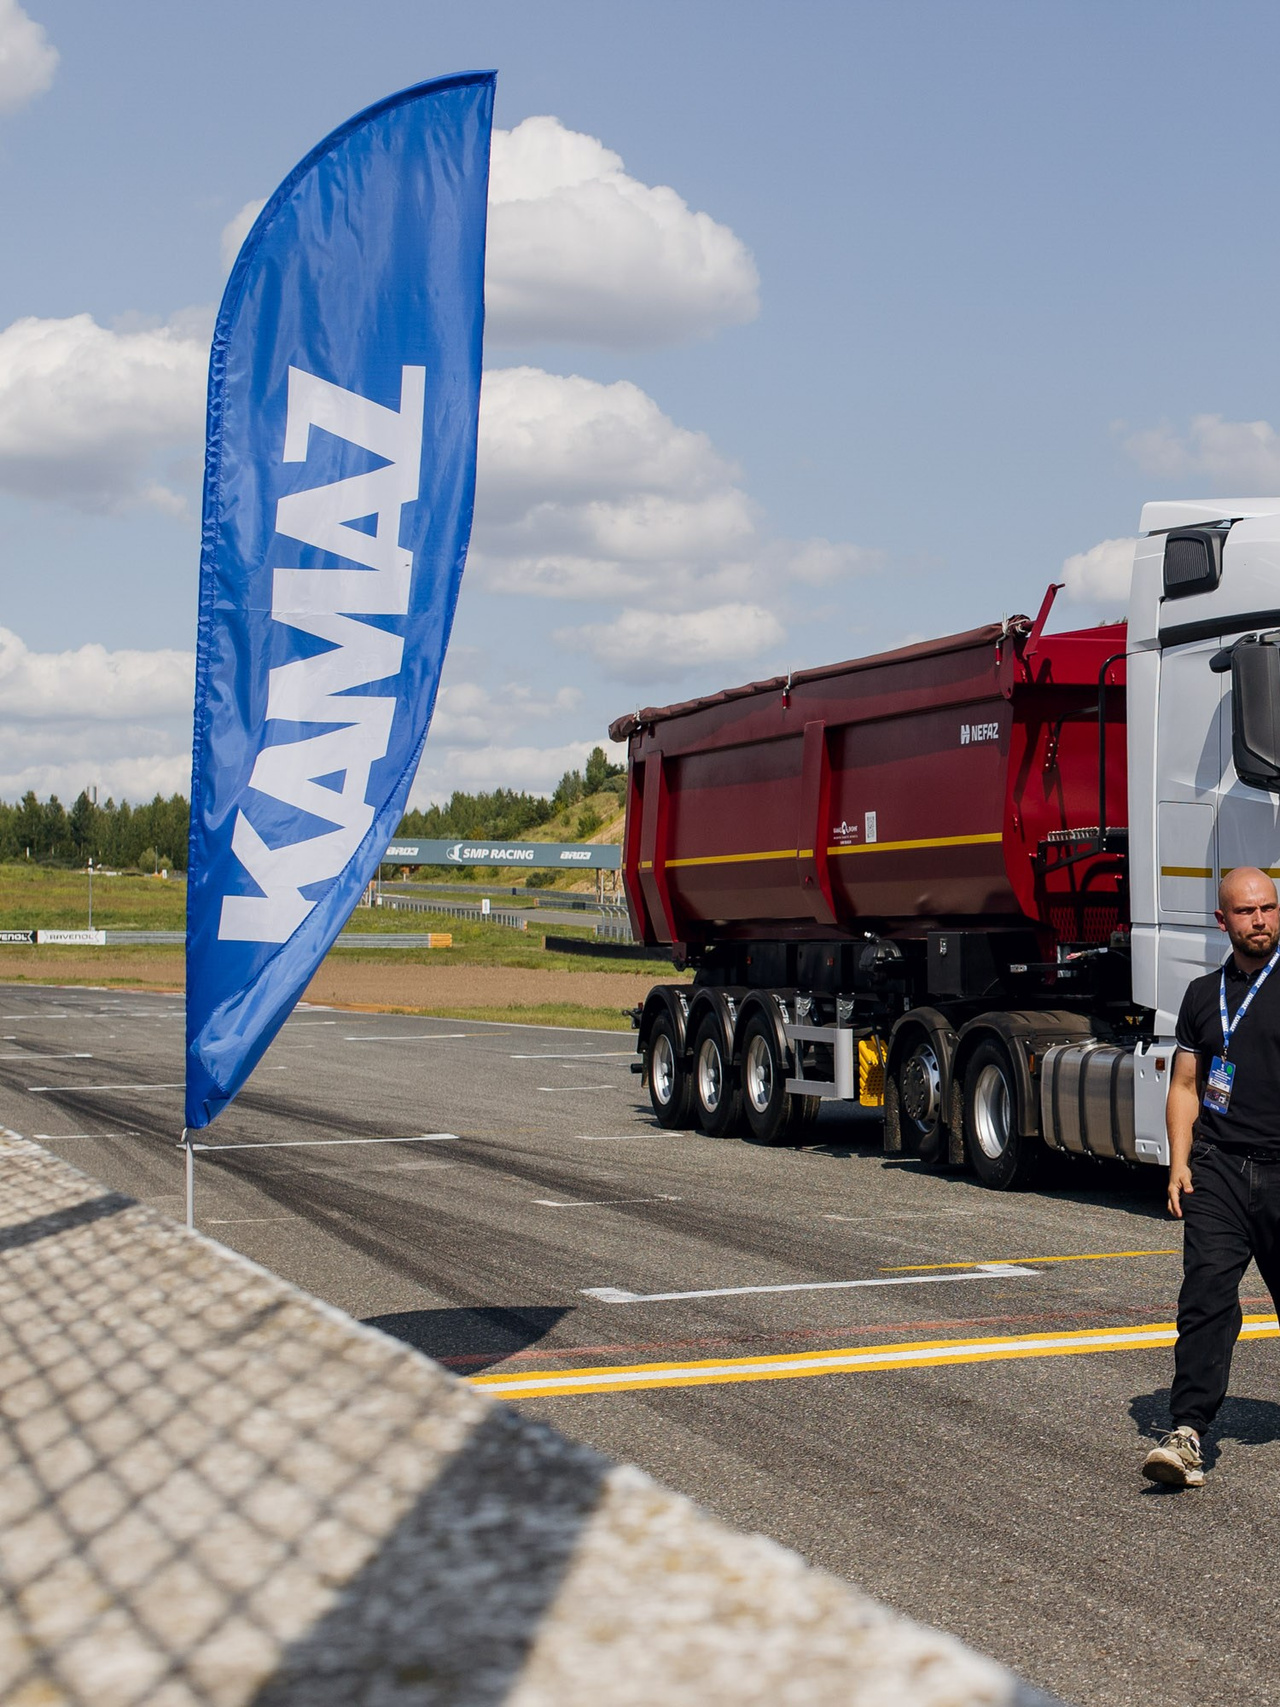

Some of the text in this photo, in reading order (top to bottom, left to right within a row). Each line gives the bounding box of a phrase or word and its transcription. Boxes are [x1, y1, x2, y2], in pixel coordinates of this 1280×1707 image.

[218, 365, 427, 943] KAMAZ
[971, 722, 999, 742] NEFAZ
[463, 848, 534, 860] SMP RACING
